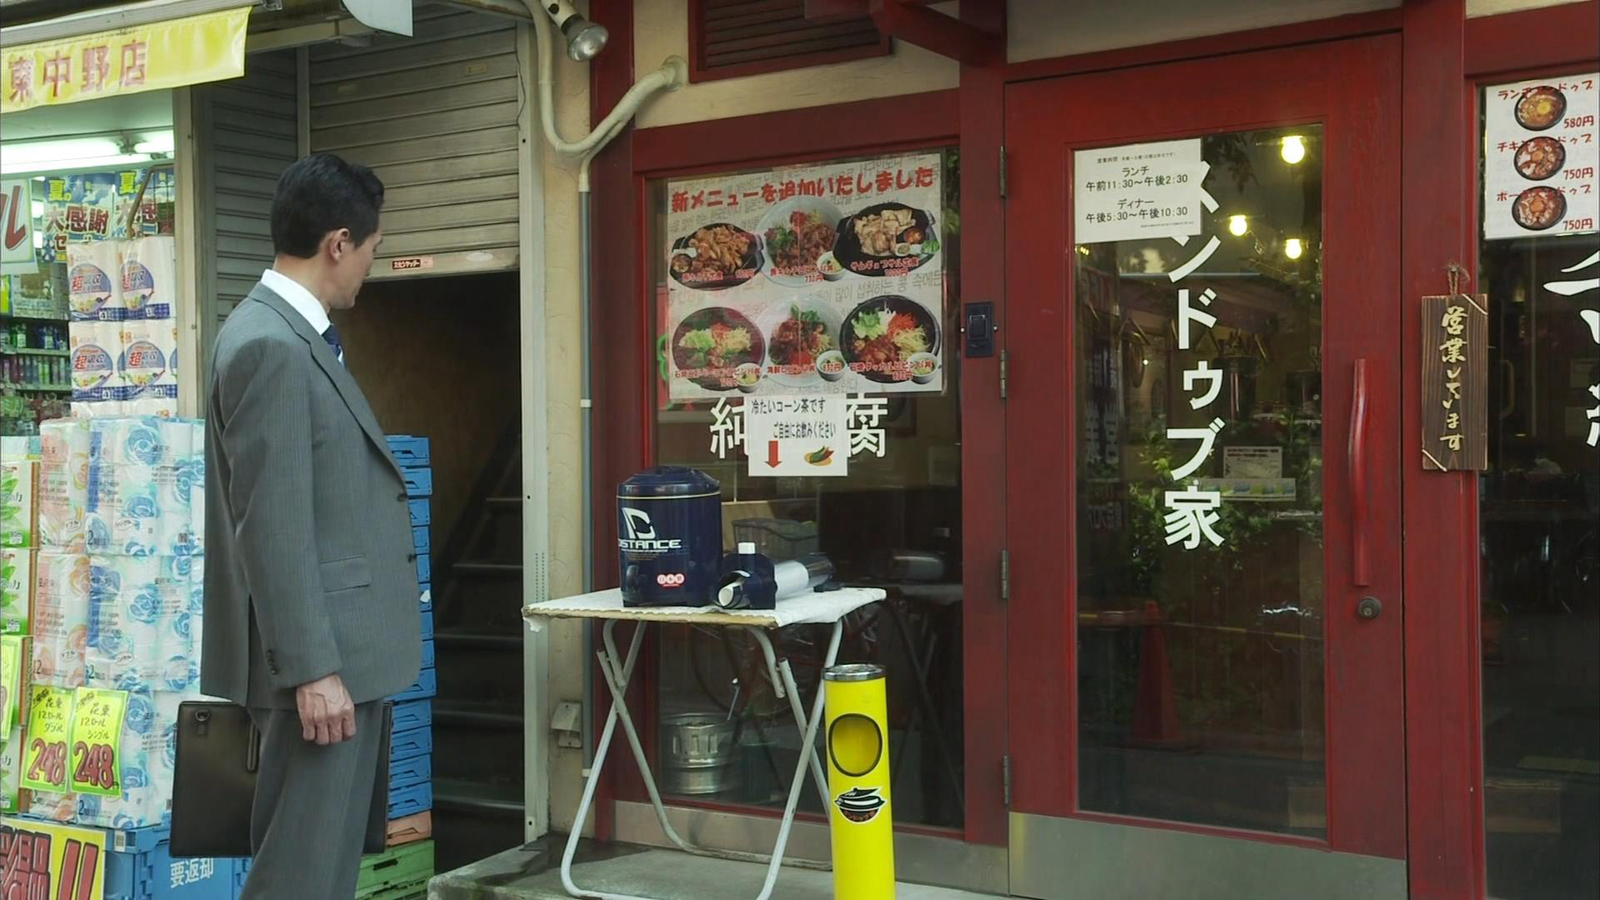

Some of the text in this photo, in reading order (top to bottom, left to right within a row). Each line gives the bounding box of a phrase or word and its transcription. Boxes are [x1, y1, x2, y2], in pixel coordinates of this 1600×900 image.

[8, 39, 147, 103] 東中野店
[1563, 115, 1594, 129] 580円
[1121, 165, 1150, 177] ランチ
[1563, 167, 1594, 181] 750円
[671, 166, 934, 213] 新メニューを追加いたしました
[1117, 199, 1154, 209] ディナー
[45, 204, 110, 235] 大感謝
[1562, 218, 1593, 232] 750円
[1440, 305, 1468, 451] 営業しています
[752, 398, 826, 415] 冷たいコーン茶です
[774, 421, 837, 440] ご自由にお飲みください
[27, 738, 67, 787] 248
[73, 740, 115, 790] 248
[169, 857, 215, 889] 要返却
